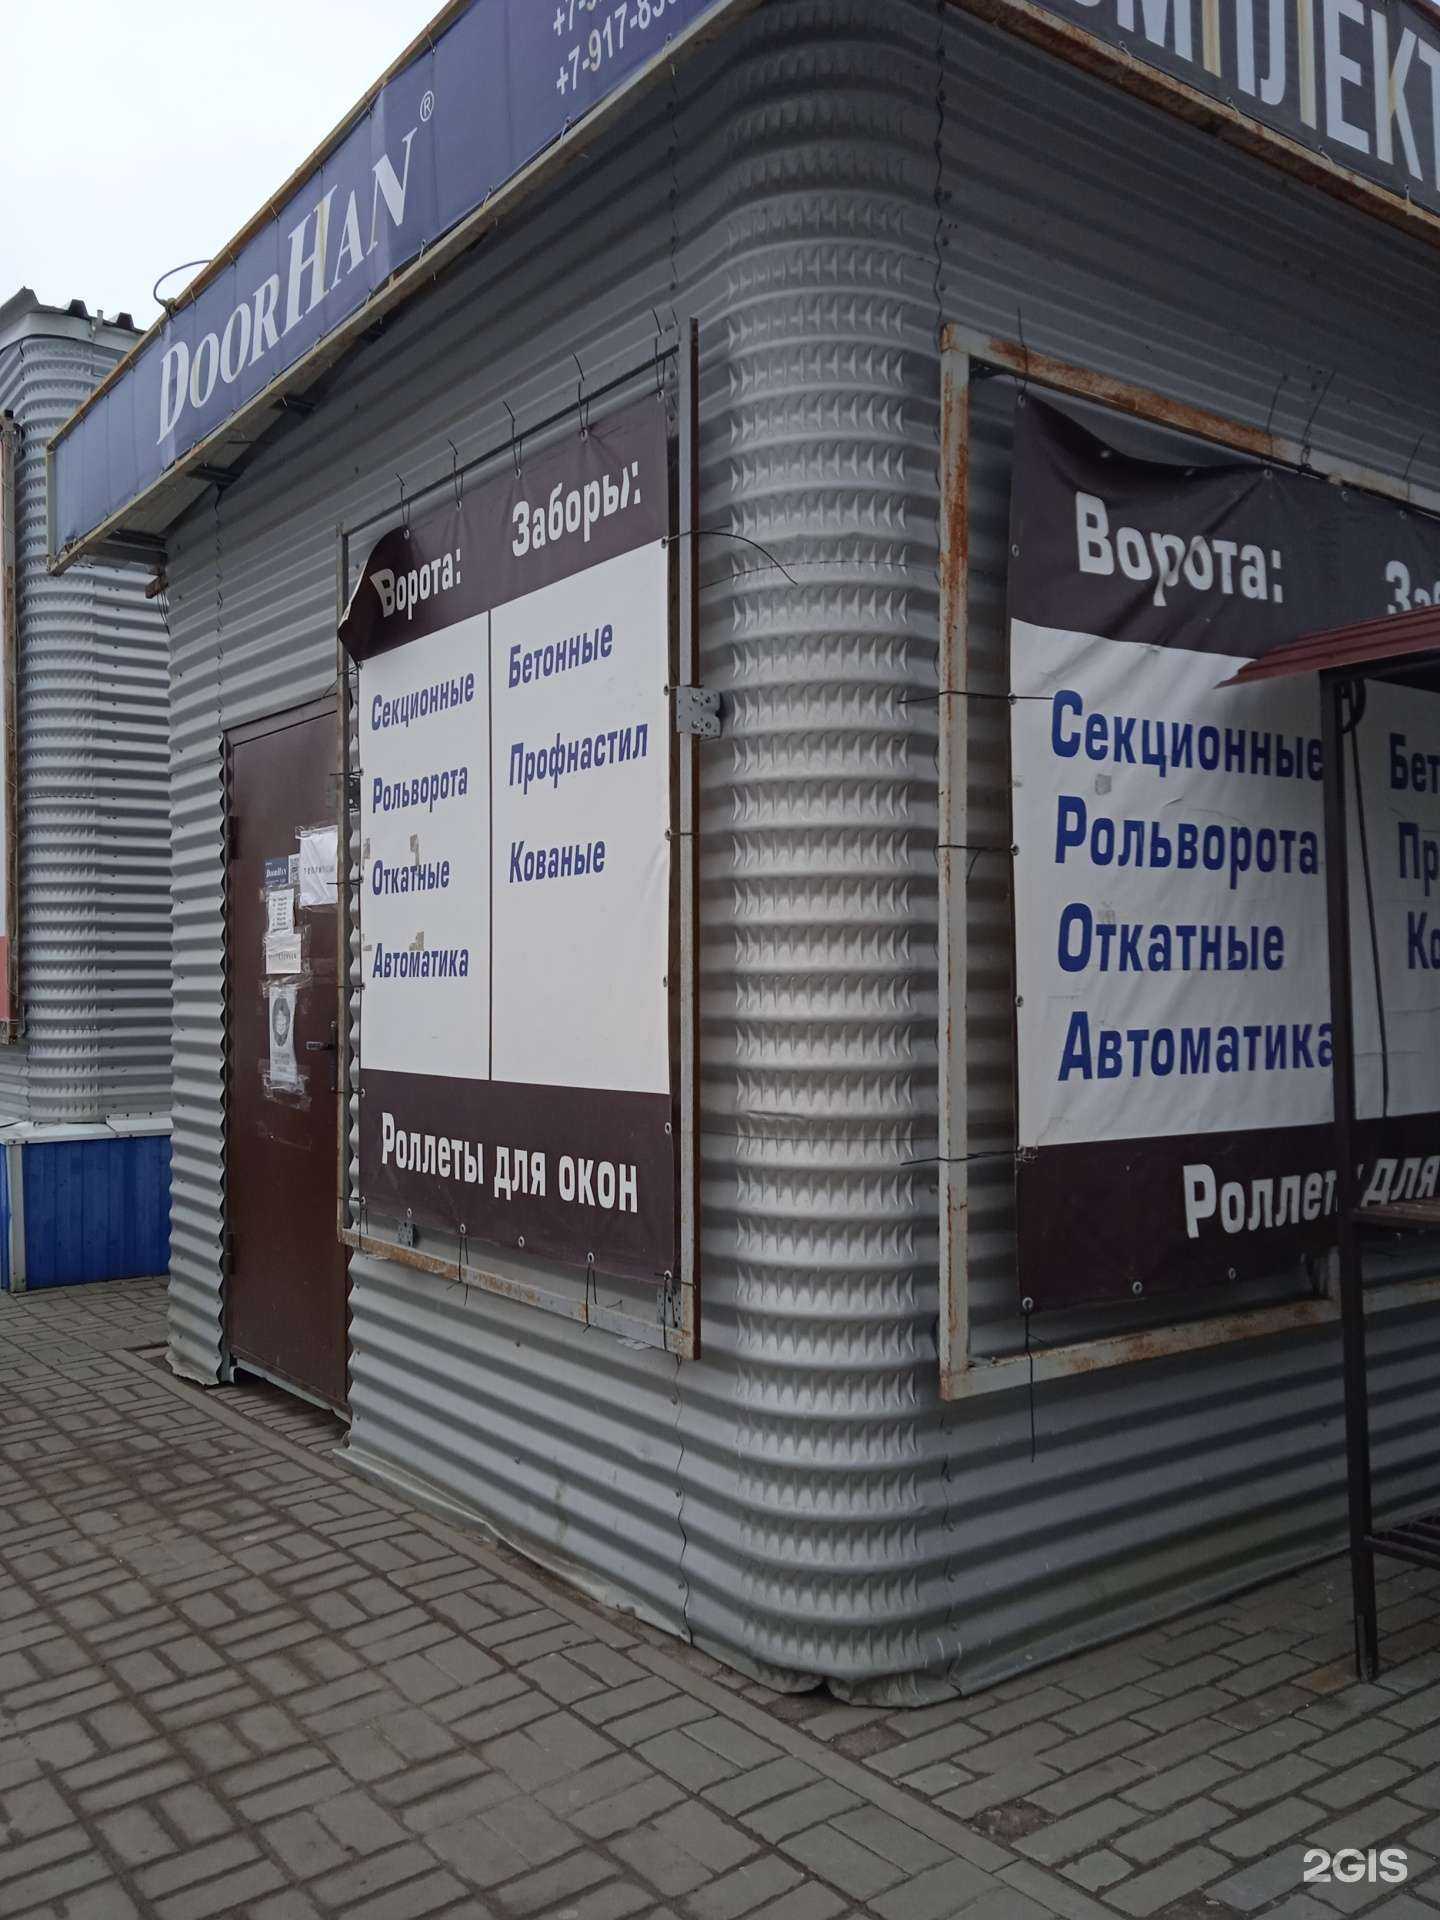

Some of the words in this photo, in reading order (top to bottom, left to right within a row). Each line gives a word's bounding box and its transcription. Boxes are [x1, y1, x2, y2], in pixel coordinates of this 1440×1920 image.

[553, 0, 596, 36] +7-
[556, 0, 676, 95] +7-917-8
[512, 461, 641, 557] Заборы:
[370, 548, 461, 620] Ворота:
[1075, 491, 1283, 606] Ворота:
[508, 623, 613, 689] Бетонные
[371, 672, 475, 731] Секционные
[1051, 690, 1323, 781] Секционные
[372, 766, 468, 813] Рольворота
[509, 723, 649, 795] Профнастил
[372, 858, 450, 895] Откатные
[508, 840, 606, 883] Кованые
[1055, 795, 1319, 889] Рольворота
[372, 942, 469, 979] Автоматика
[1058, 902, 1284, 972] Откатные
[1058, 1011, 1335, 1081] Автоматика
[381, 1112, 484, 1184] Роллеты
[494, 1145, 546, 1200] для
[558, 1155, 639, 1213] окон
[1183, 1163, 1364, 1240] Роллет
[1360, 1155, 1440, 1207] для
